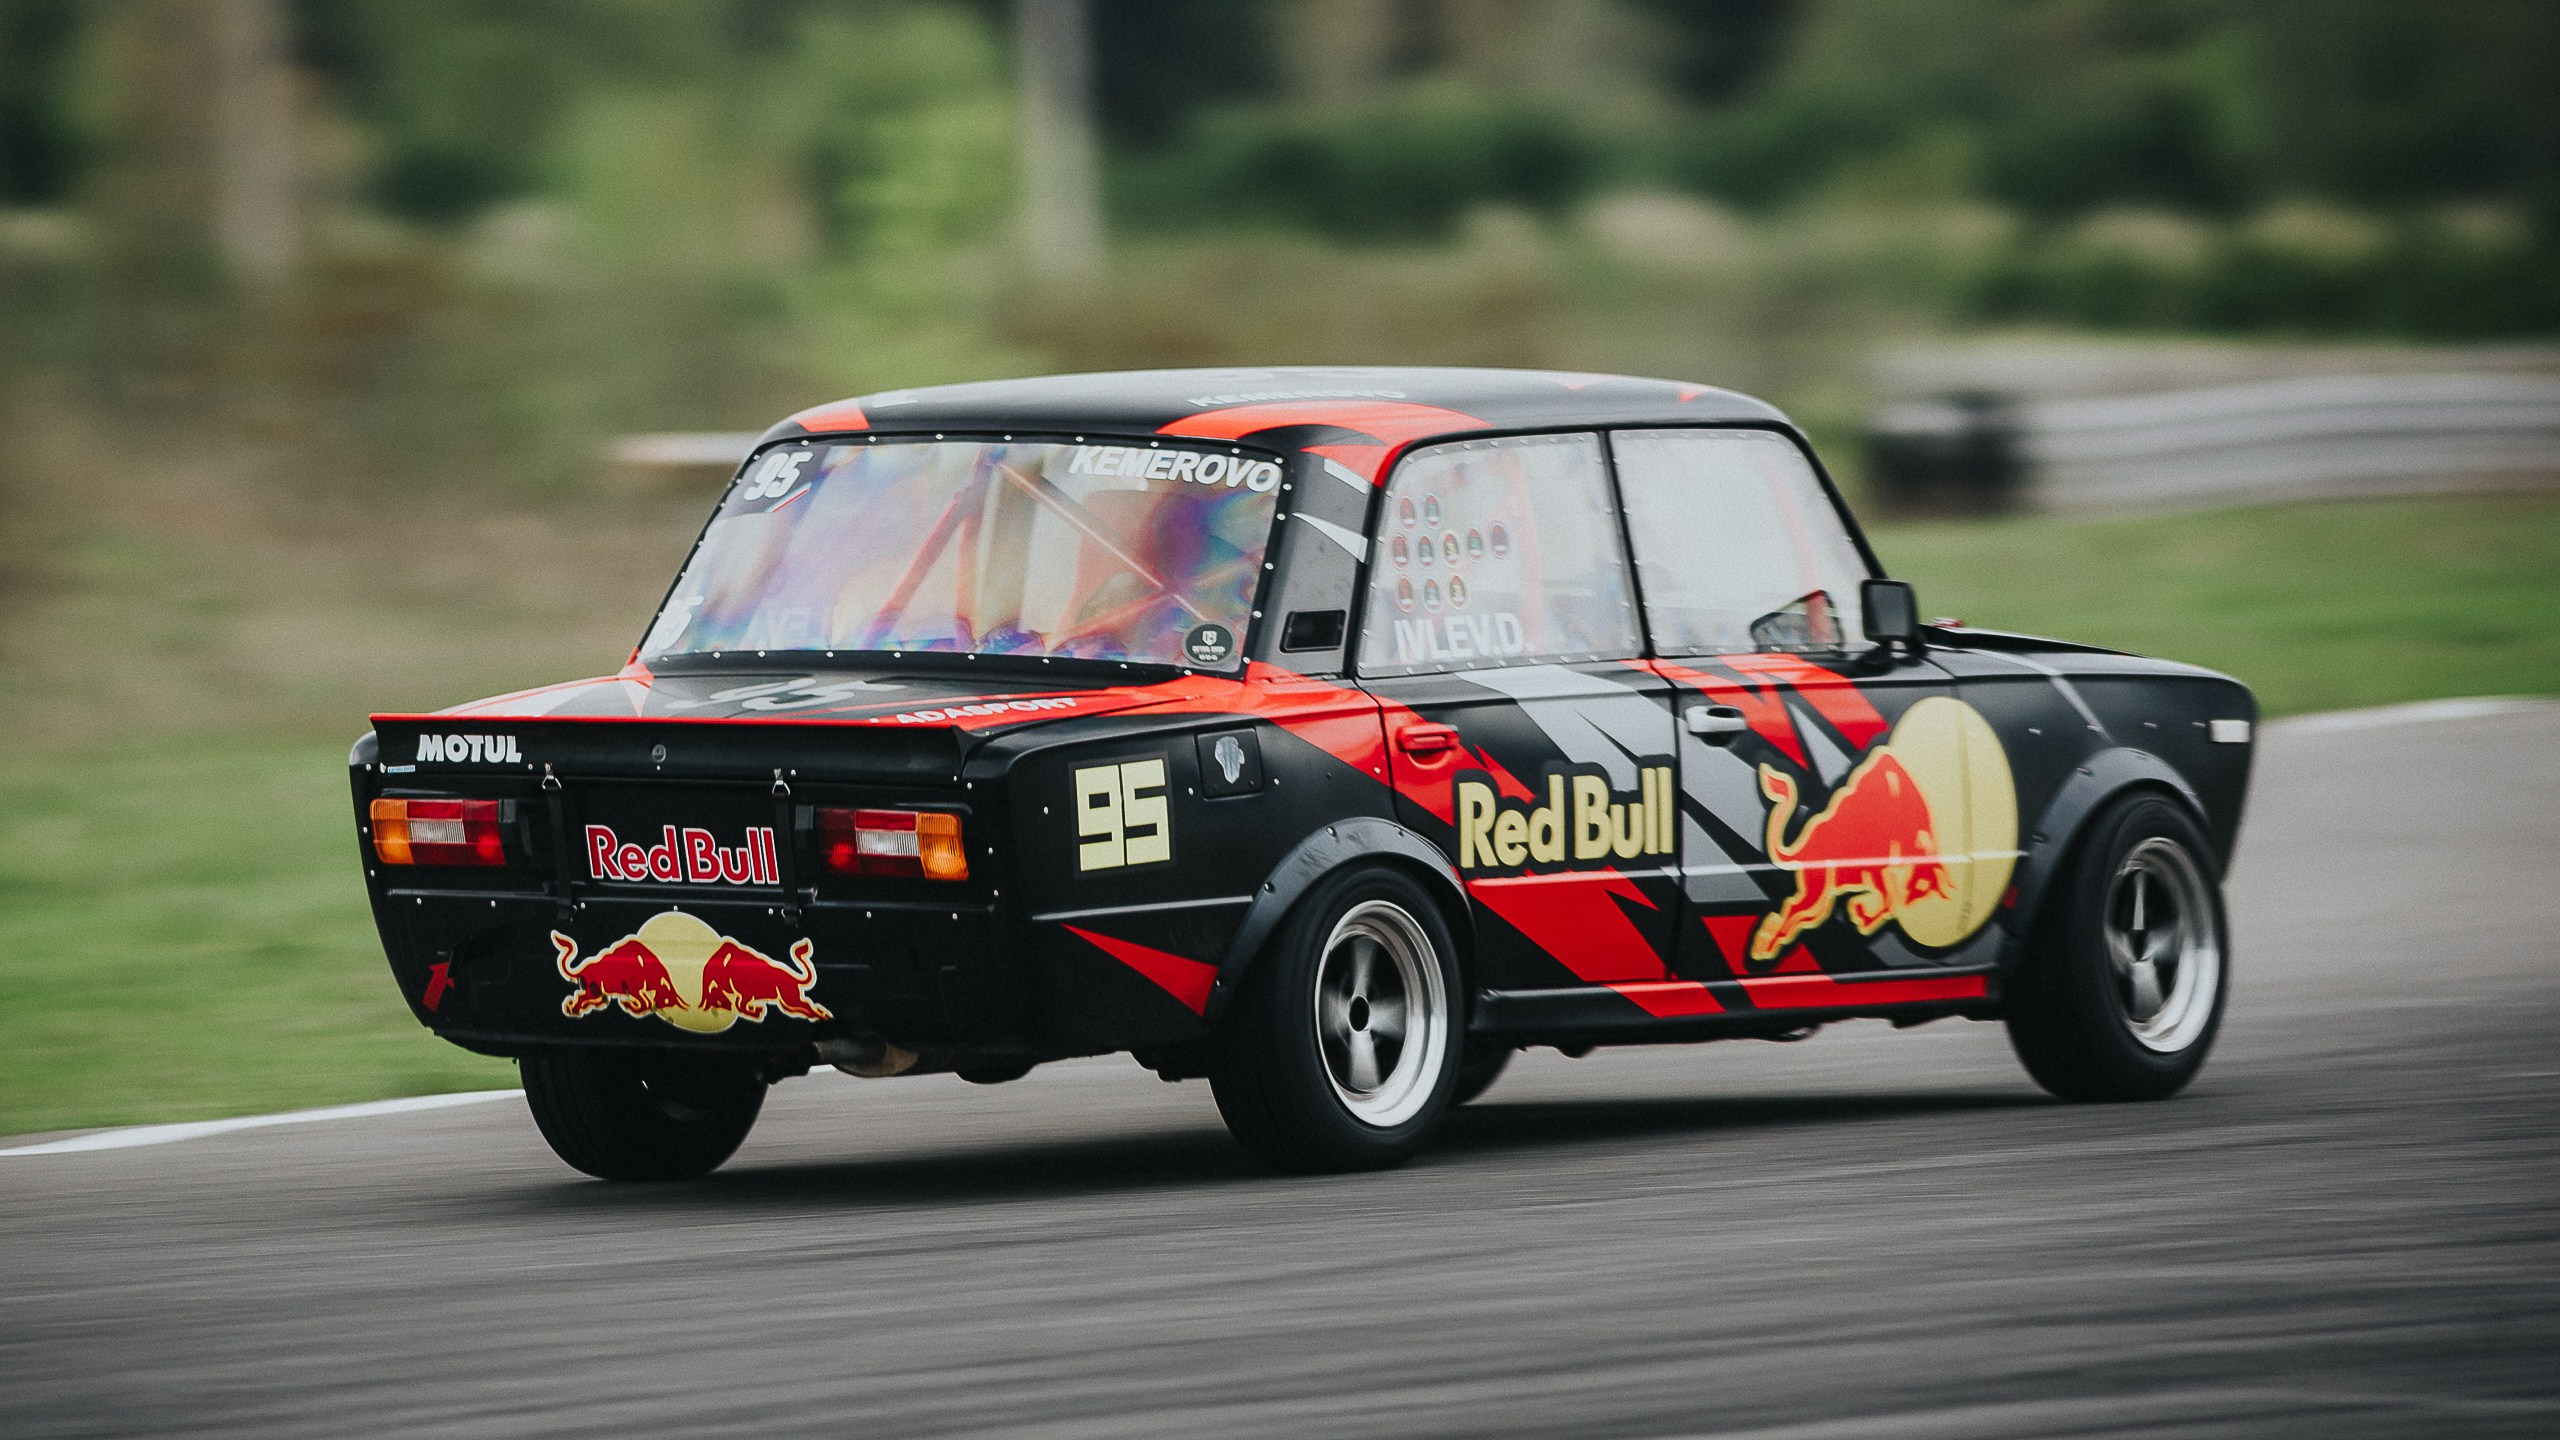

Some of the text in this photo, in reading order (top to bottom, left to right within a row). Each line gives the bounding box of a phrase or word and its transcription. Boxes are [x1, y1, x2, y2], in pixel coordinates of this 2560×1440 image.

[744, 452, 814, 501] 95
[1068, 445, 1280, 493] KEMEROVO
[870, 697, 1077, 725] ADASPORT
[416, 734, 523, 763] MOTUL
[1075, 758, 1170, 871] 95
[1458, 766, 1674, 869] Red Bull
[586, 825, 780, 884] Red Bull
